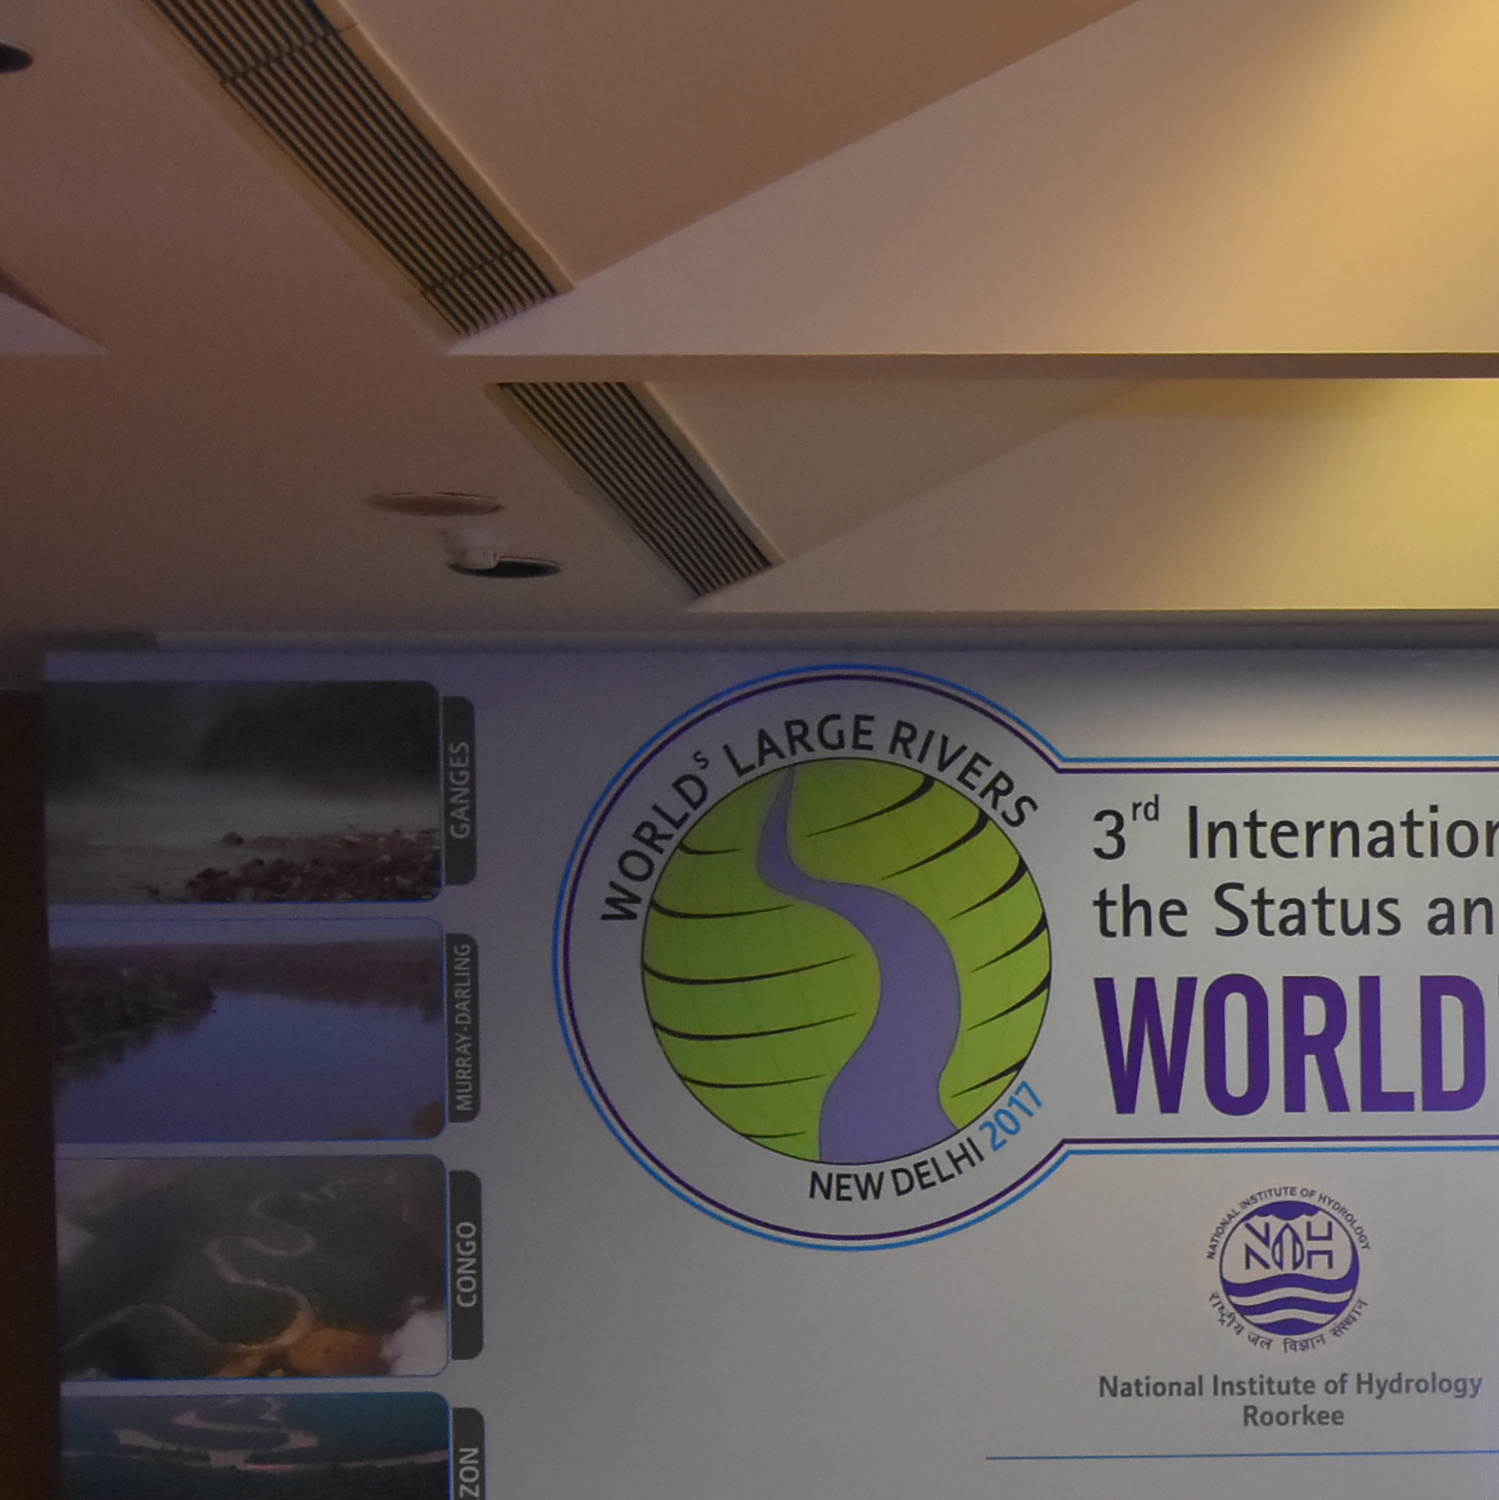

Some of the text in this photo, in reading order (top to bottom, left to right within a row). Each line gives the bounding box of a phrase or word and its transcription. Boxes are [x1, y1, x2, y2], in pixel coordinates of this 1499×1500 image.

[450, 742, 469, 840] GANGES
[723, 714, 875, 778] LARGE
[889, 720, 1039, 829] RIVERS
[1093, 793, 1159, 860] 3rd
[1093, 883, 1187, 938] the
[1214, 881, 1401, 937] Status
[456, 943, 472, 1112] MURRAY-DARLING
[809, 1081, 1044, 1202] NEW DELHI 2017
[1206, 1186, 1371, 1259] NATIONAL INSTITUTE OF HYDROLOGY
[457, 1221, 476, 1308] CONGO
[1100, 1371, 1482, 1400] National Institute of Hydrology
[1243, 1405, 1344, 1426] Roorkee
